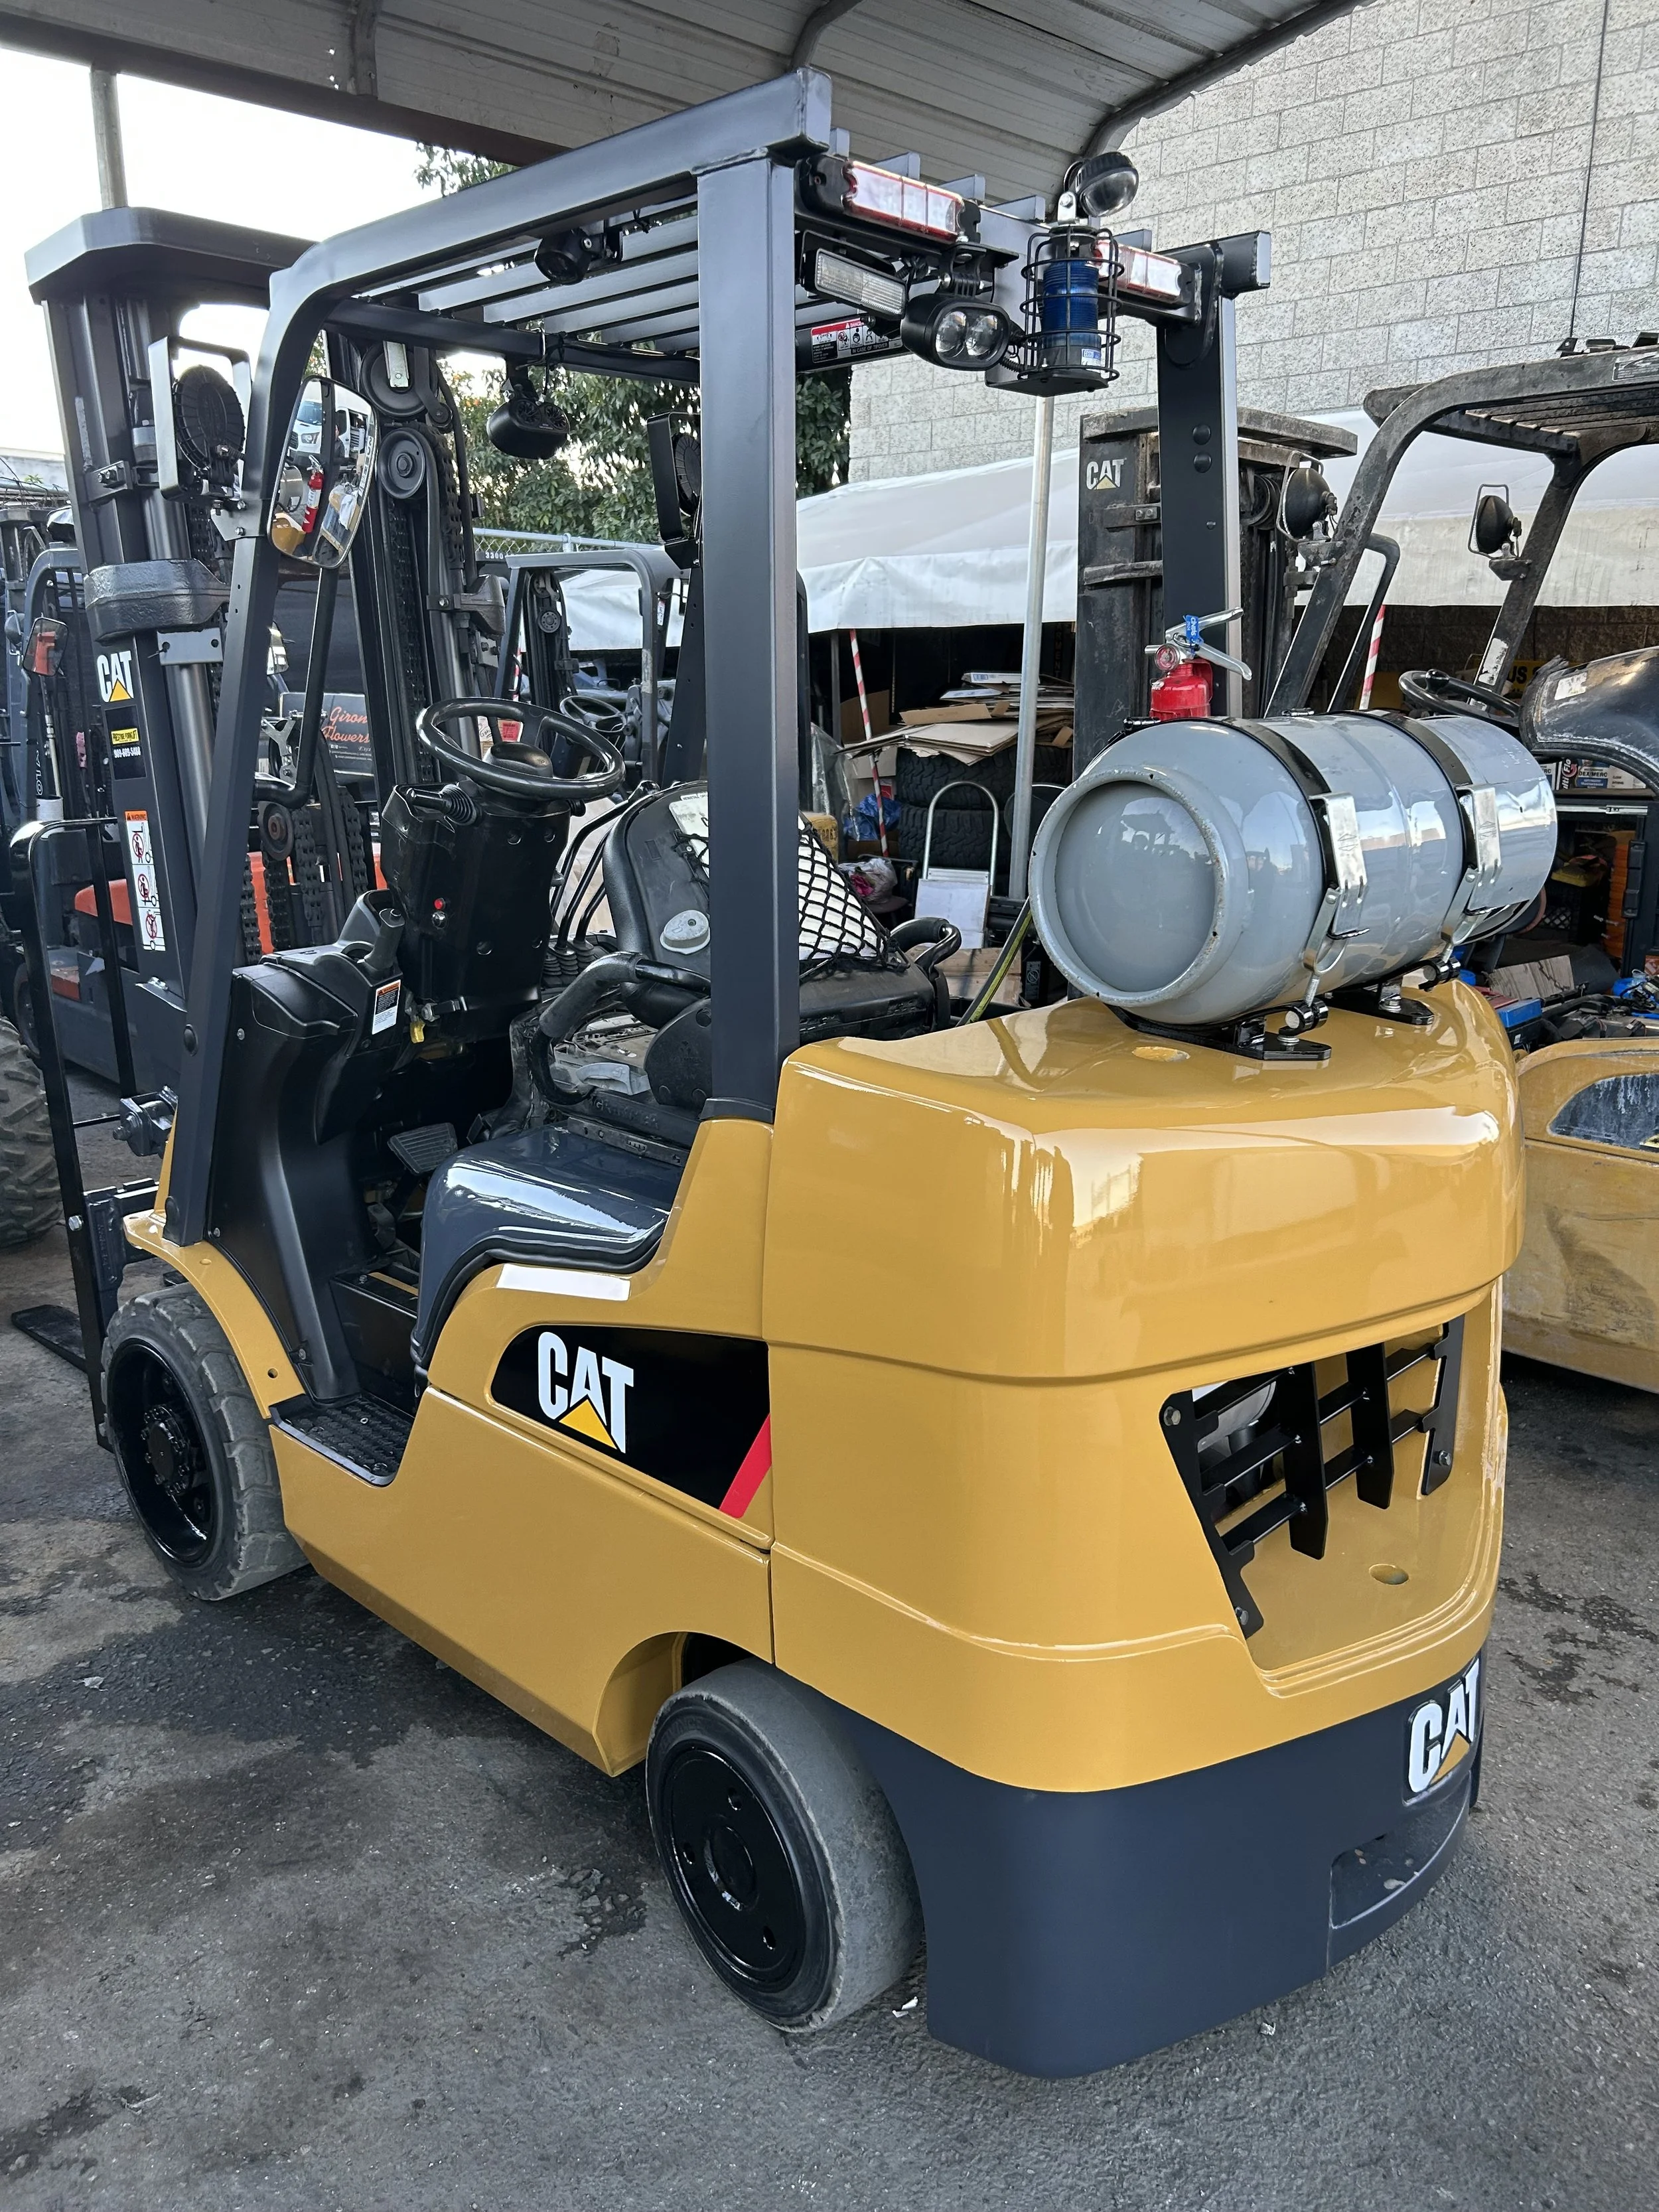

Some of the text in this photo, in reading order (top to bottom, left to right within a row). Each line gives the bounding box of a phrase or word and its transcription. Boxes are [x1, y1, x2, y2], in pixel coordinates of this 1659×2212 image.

[1086, 459, 1124, 490] CAT
[97, 650, 134, 702] CAT
[330, 706, 368, 725] Giron
[321, 726, 370, 743] Flowers
[1563, 759, 1571, 773] Flo
[538, 1331, 634, 1453] CAT
[1408, 1657, 1480, 1793] CAT
